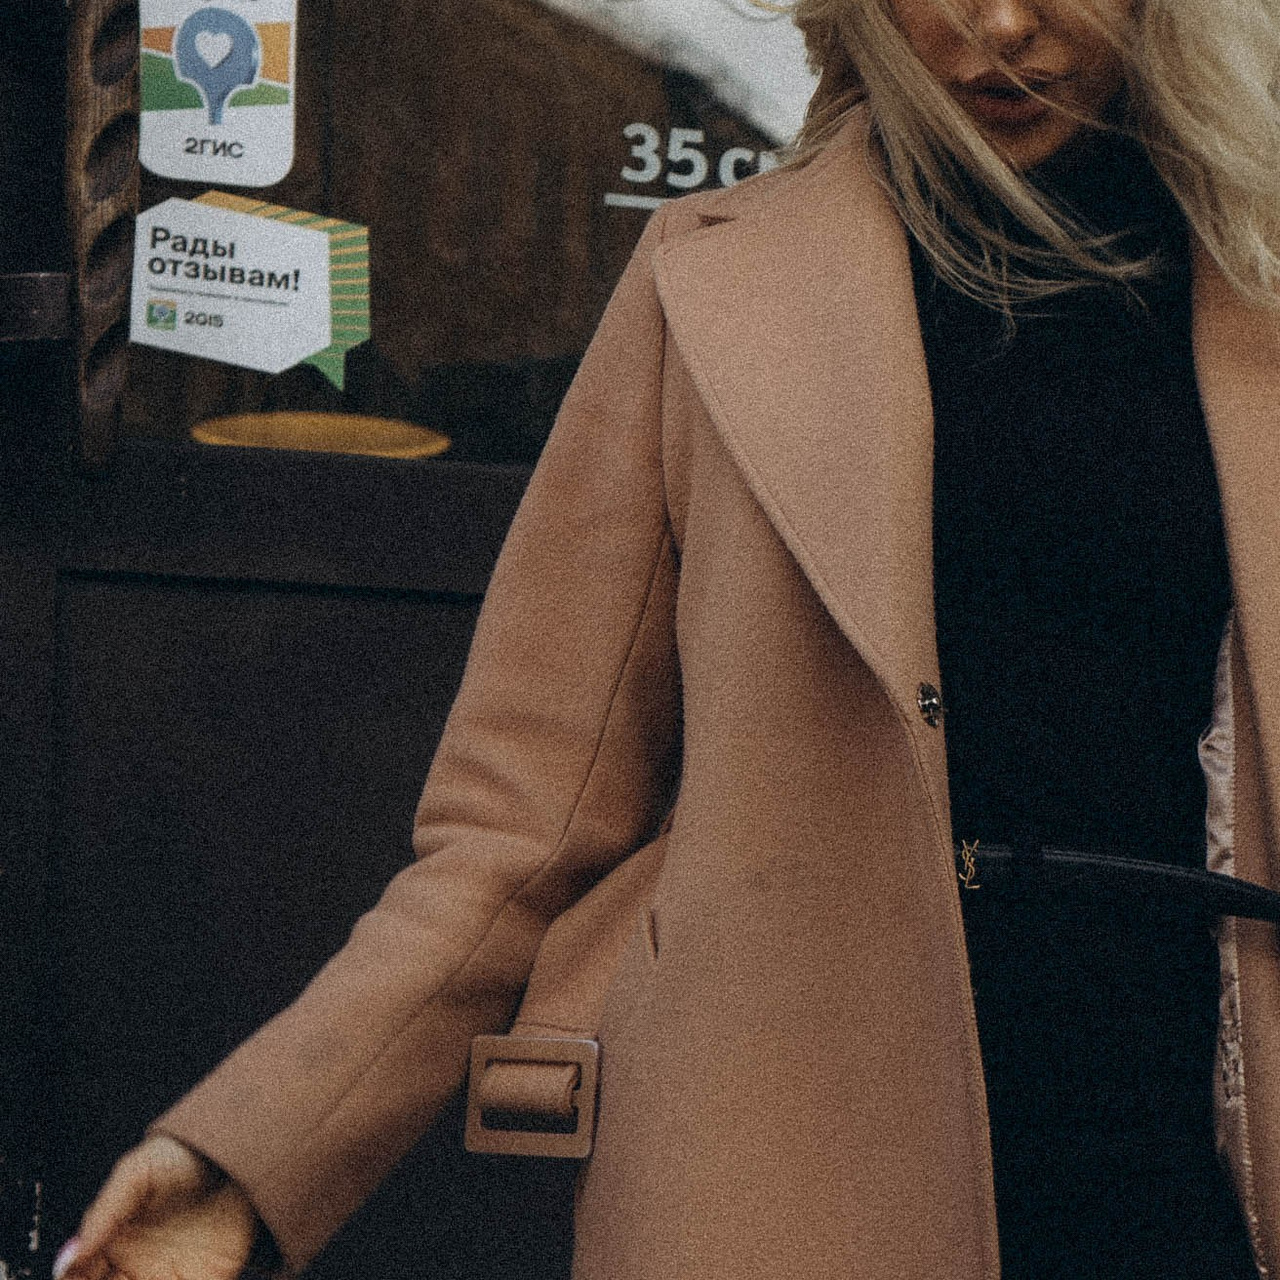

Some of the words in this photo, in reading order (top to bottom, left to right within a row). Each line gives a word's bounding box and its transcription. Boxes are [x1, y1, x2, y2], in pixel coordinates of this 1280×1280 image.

[184, 136, 244, 159] 2ГИС
[149, 225, 236, 259] Рады
[148, 256, 301, 291] отзывам!
